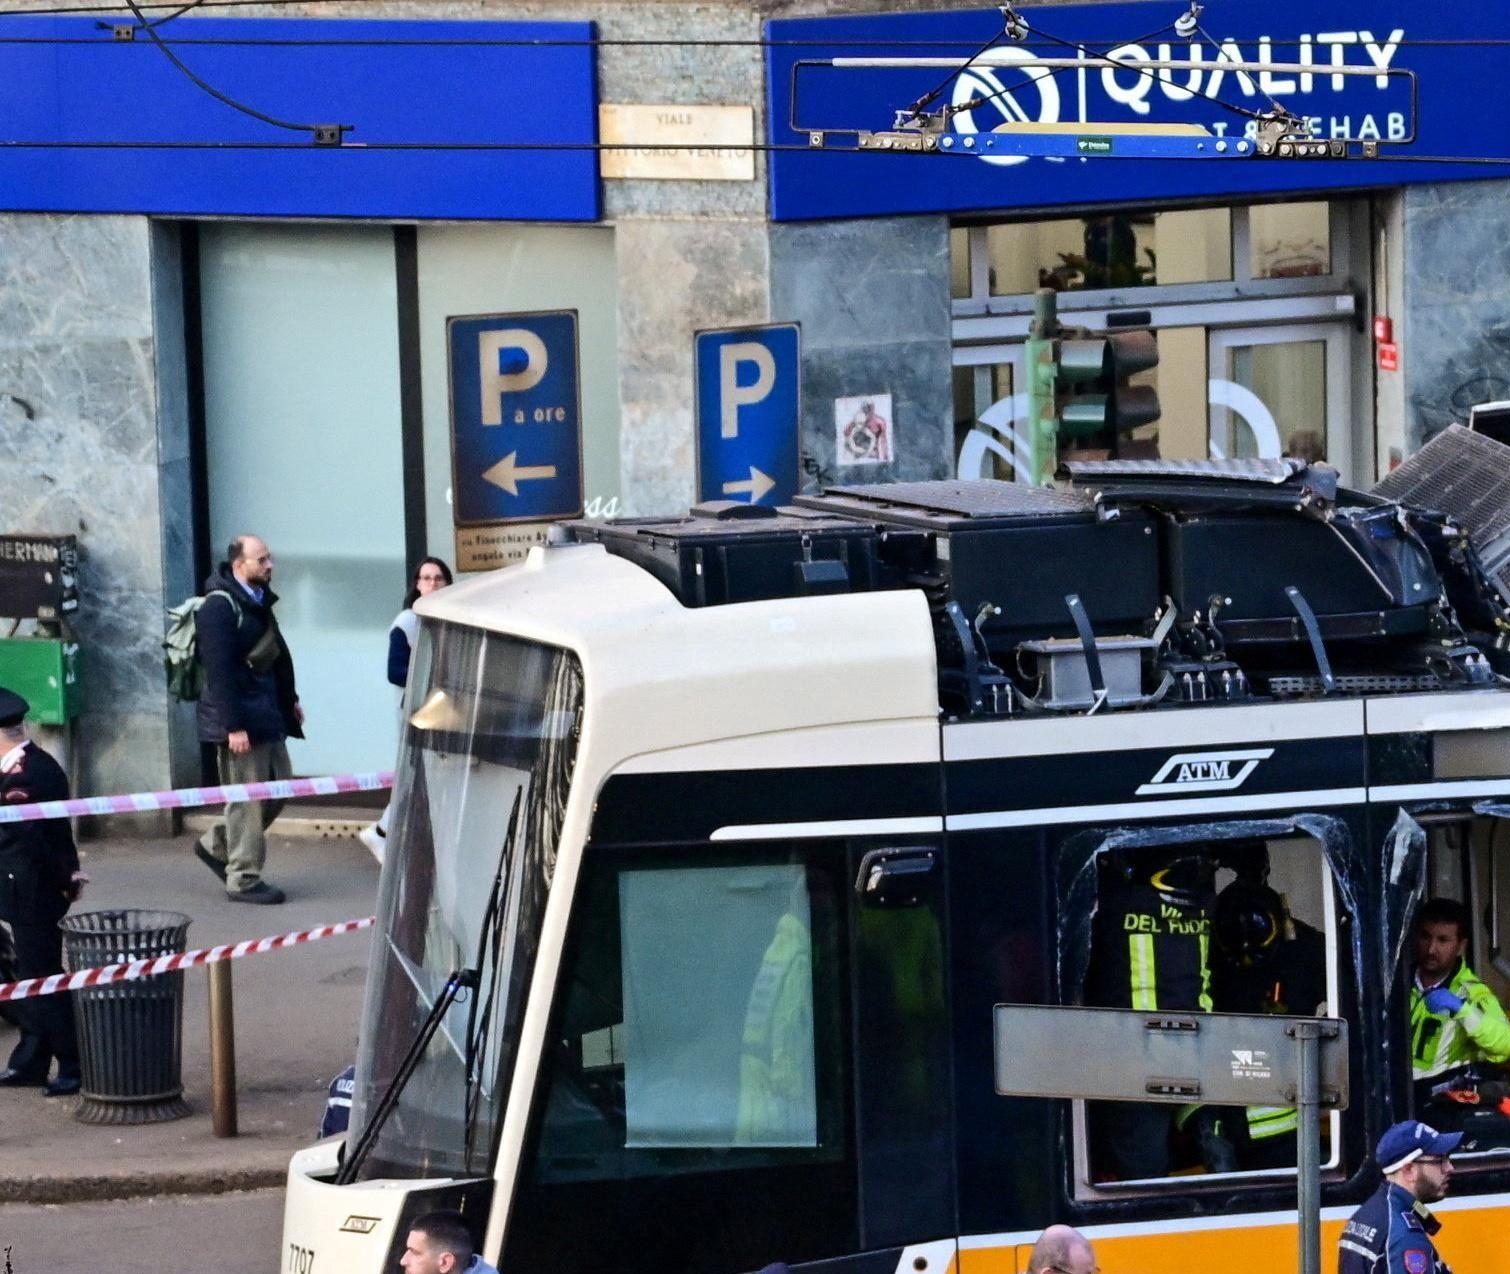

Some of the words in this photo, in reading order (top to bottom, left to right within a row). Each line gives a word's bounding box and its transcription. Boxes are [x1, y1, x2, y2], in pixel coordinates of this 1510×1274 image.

[1101, 29, 1404, 114] QUALITY
[657, 113, 693, 125] VIALE
[1285, 112, 1406, 140] EHAB
[479, 329, 548, 426] P
[720, 342, 776, 439] P
[514, 409, 525, 424] a
[534, 406, 566, 422] ore
[1176, 761, 1230, 782] ATM
[1124, 913, 1162, 933] DEL
[350, 1219, 368, 1231] ATM
